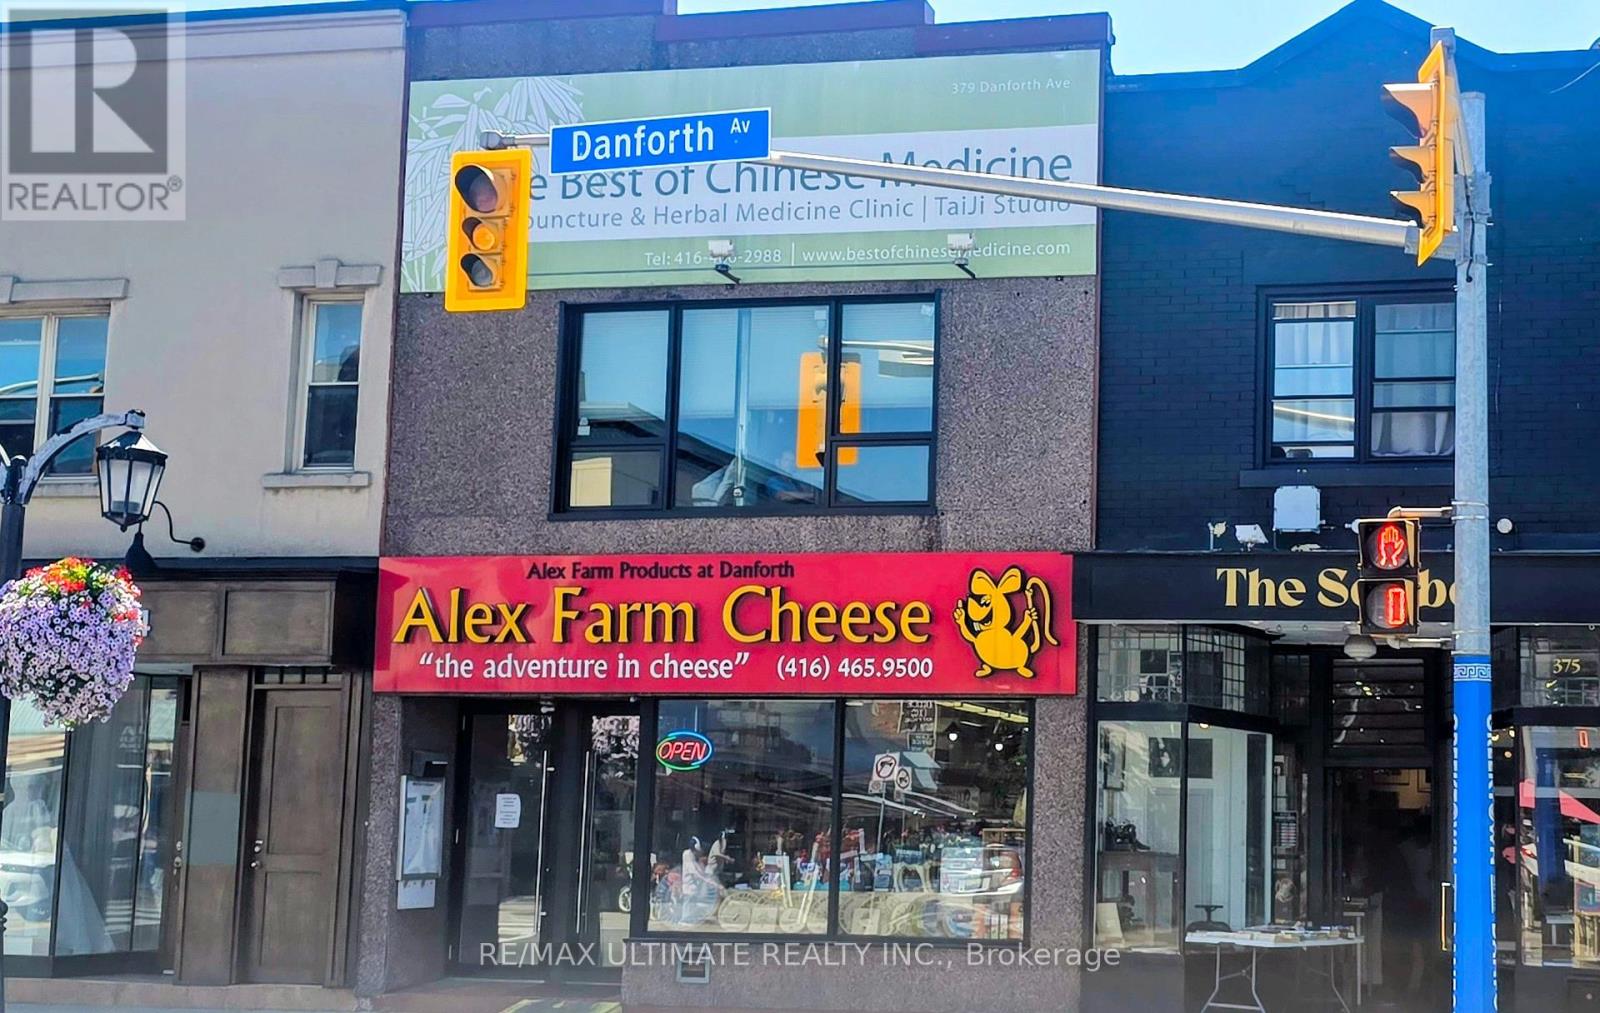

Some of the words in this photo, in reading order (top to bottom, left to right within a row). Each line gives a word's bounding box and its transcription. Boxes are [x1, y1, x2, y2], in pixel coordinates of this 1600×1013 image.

[951, 82, 976, 95] 379
[980, 79, 1041, 93] Danforth
[1045, 77, 1072, 90] Ave
[572, 120, 714, 162] Danforth
[730, 117, 751, 135] Av
[562, 169, 643, 199] Best
[654, 164, 695, 195] of
[630, 206, 646, 226] &
[654, 203, 727, 225] Herbal
[736, 201, 841, 222] Medicine
[849, 198, 914, 219] Clinic
[934, 196, 985, 217] TaiJi
[644, 251, 671, 266] Tel:
[526, 562, 566, 580] Alex
[571, 562, 614, 580] Farm
[619, 561, 692, 579] Products
[697, 562, 714, 578] at
[719, 560, 795, 578] Danforth
[1216, 568, 1307, 607] The
[393, 586, 532, 643] Alex
[552, 586, 696, 643] Farm
[722, 584, 932, 643] Cheese
[419, 652, 474, 679] “the
[483, 653, 608, 679] adventure
[617, 652, 640, 679] in
[649, 652, 750, 679] cheese”
[777, 655, 831, 680] (416)
[837, 657, 934, 678] 465.9500
[1552, 658, 1581, 674] 375
[658, 742, 707, 760] OPEN
